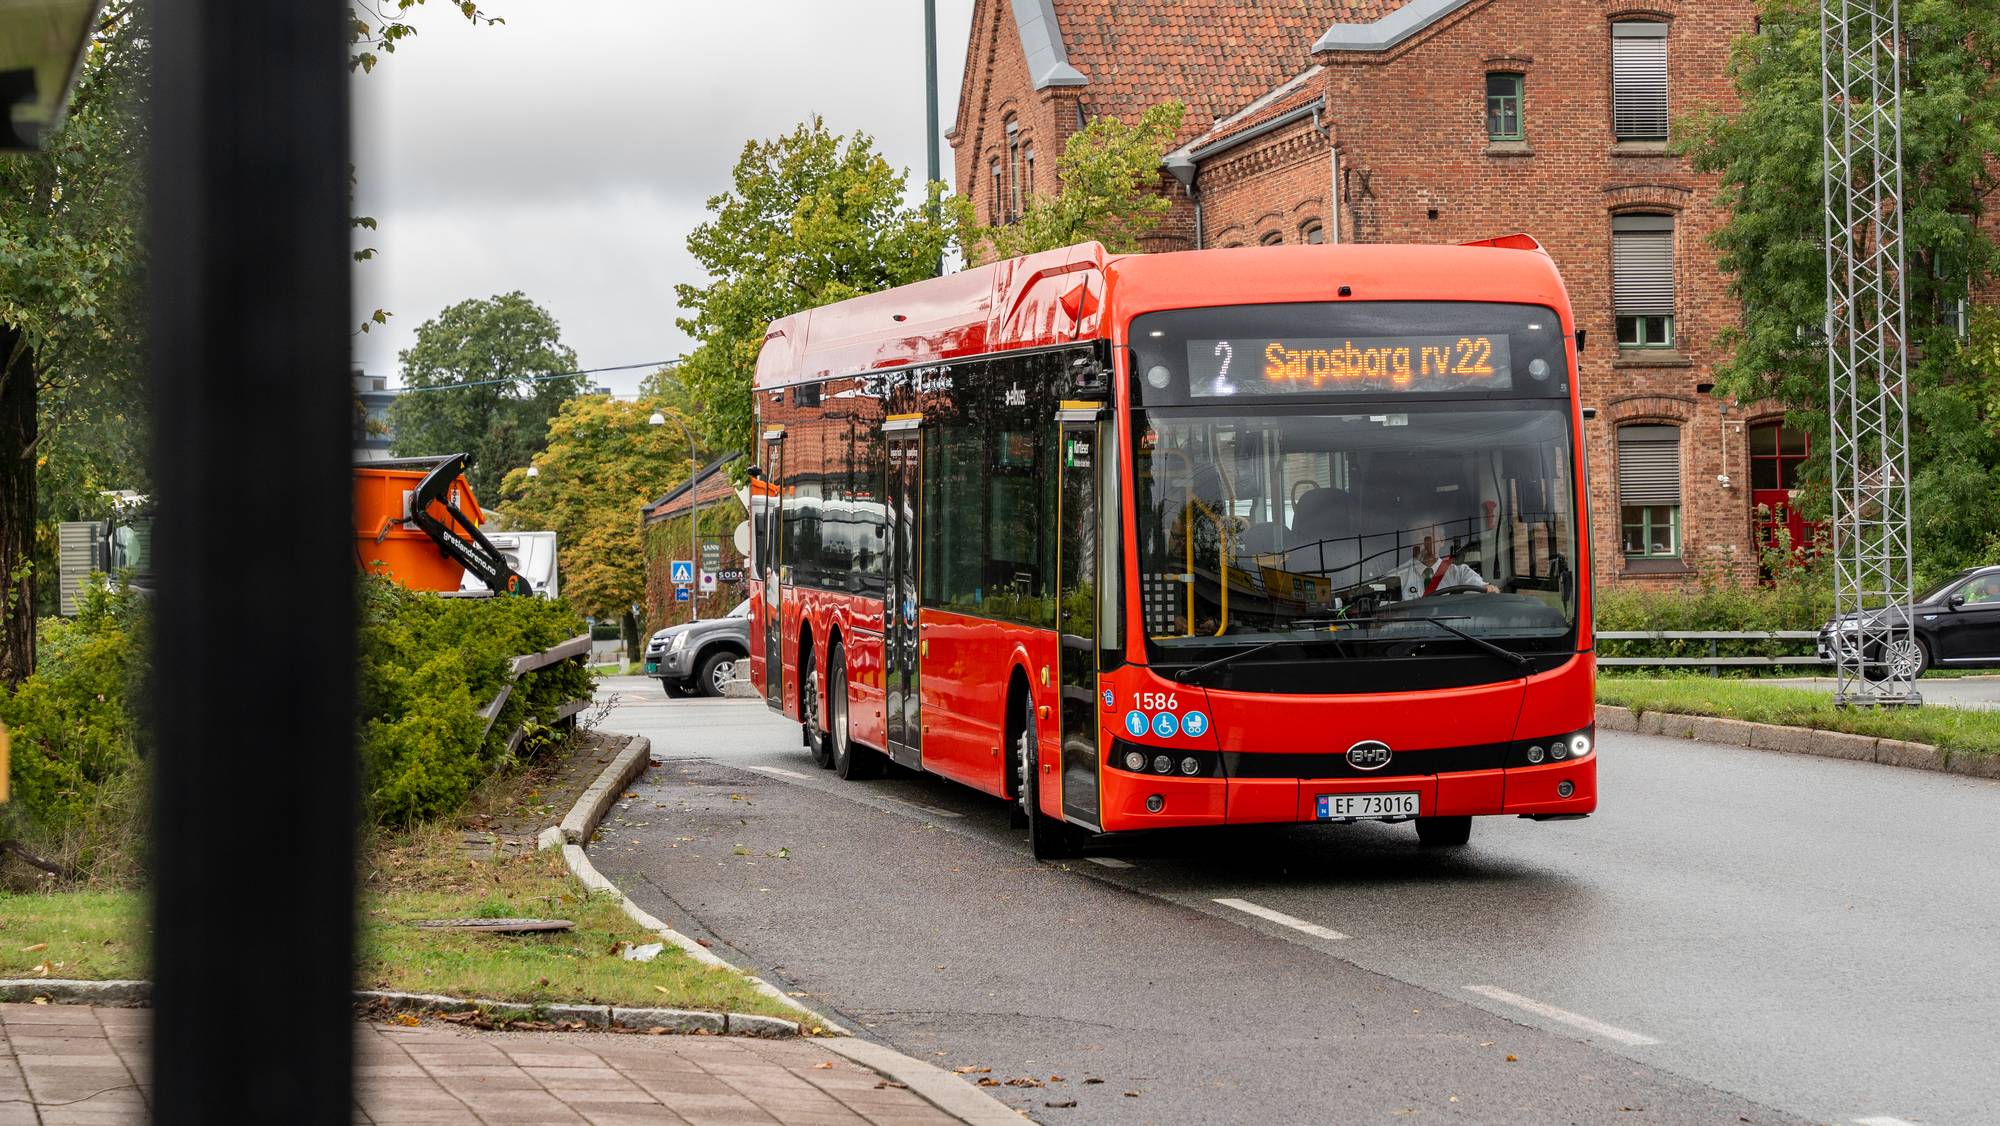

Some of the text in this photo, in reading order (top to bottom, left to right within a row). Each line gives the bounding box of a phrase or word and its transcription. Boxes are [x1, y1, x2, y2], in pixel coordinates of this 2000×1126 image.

[1214, 337, 1492, 394] 2 Sarpsborg rv.22
[718, 570, 744, 578] SODA
[1133, 692, 1178, 710] 1586
[1352, 749, 1387, 762] BYD
[1335, 796, 1413, 815] EF 73016
